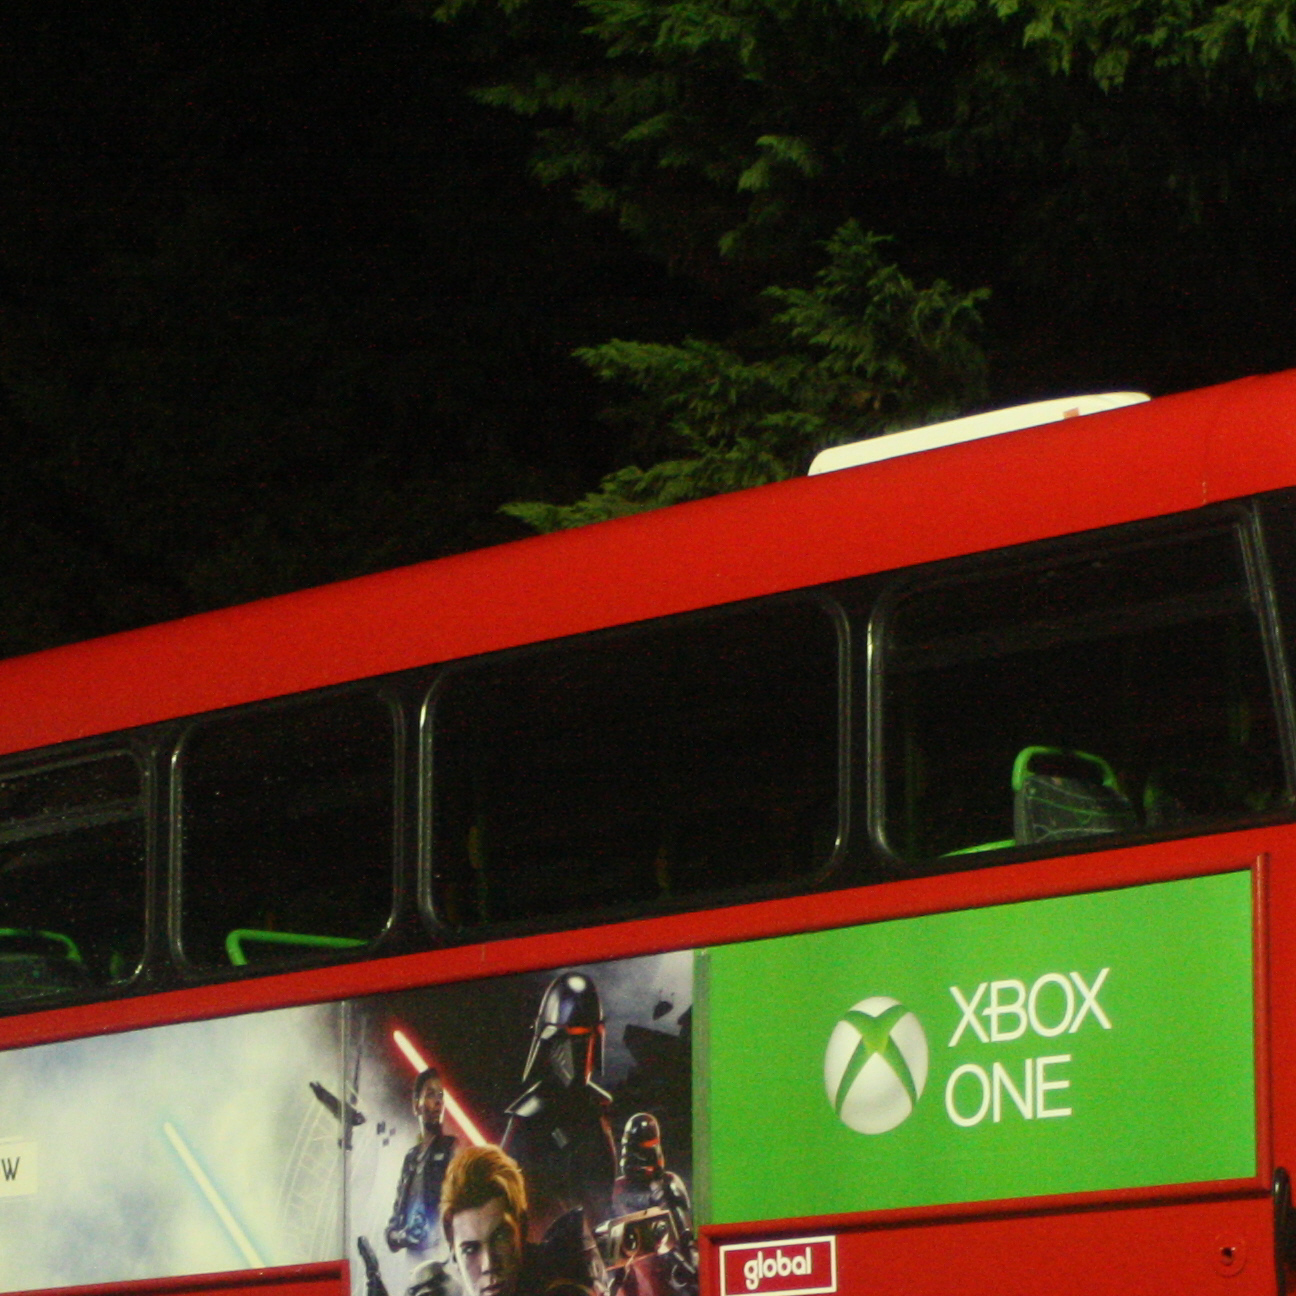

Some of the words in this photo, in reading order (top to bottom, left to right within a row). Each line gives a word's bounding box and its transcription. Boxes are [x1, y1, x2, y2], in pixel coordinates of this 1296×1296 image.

[948, 967, 1112, 1047] XBOX
[945, 1054, 1072, 1127] ONE
[743, 1246, 812, 1291] global
